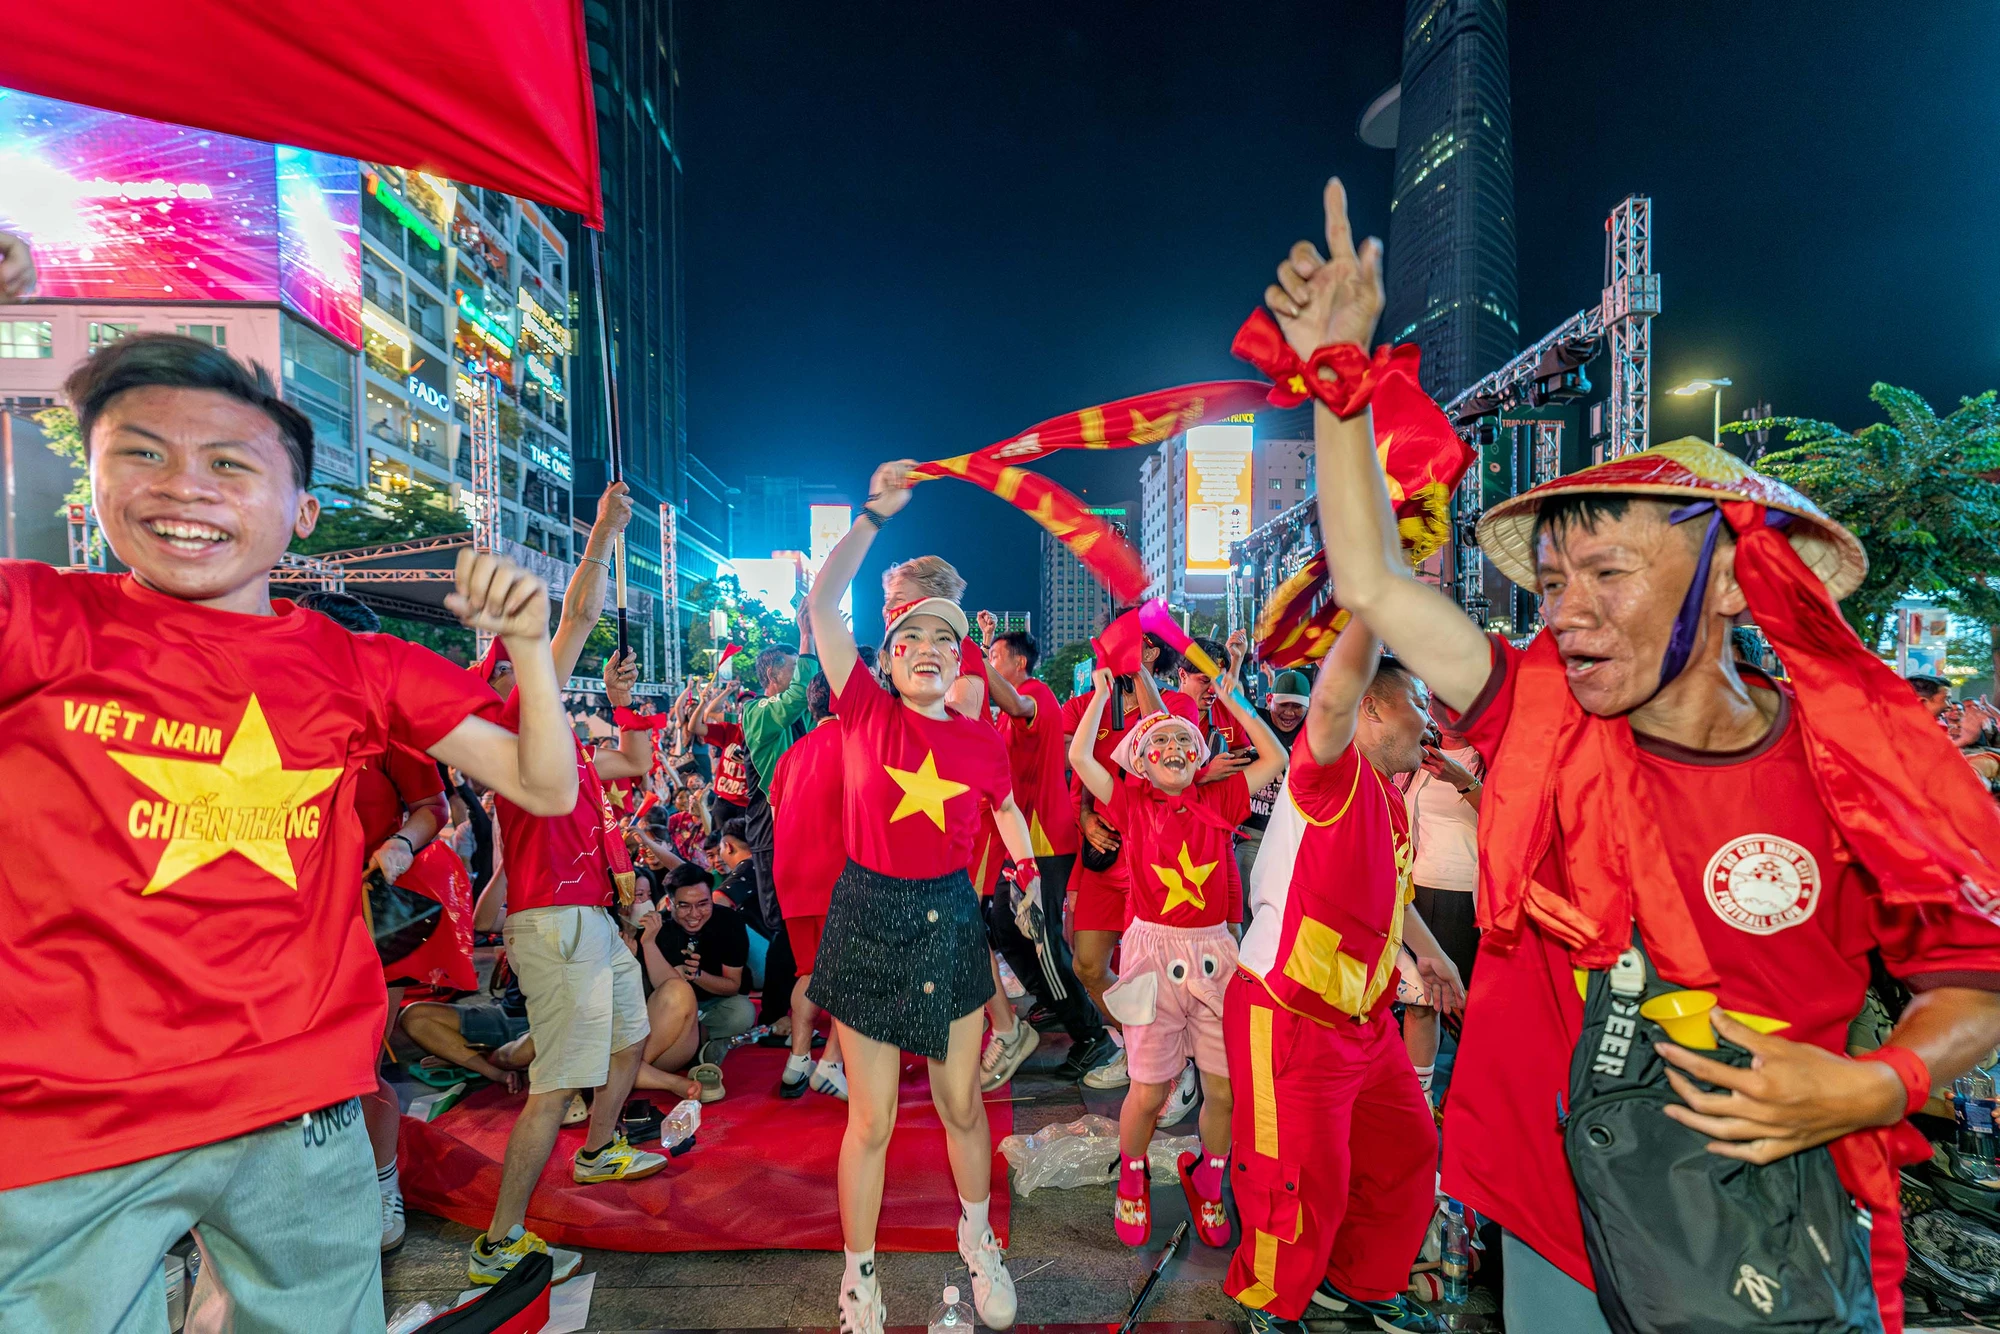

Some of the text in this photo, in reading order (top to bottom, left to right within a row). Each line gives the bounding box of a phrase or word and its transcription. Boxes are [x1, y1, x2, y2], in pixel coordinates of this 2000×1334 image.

[529, 444, 551, 470] THE
[551, 458, 572, 481] ONE
[1104, 508, 1127, 516] TOWER
[63, 700, 222, 754] VIỆT NAM
[128, 792, 321, 841] CHIẾN THẮNG
[1720, 841, 1813, 884] HO CHI MINH CITY
[1715, 889, 1804, 928] FOOTBALL CLUB
